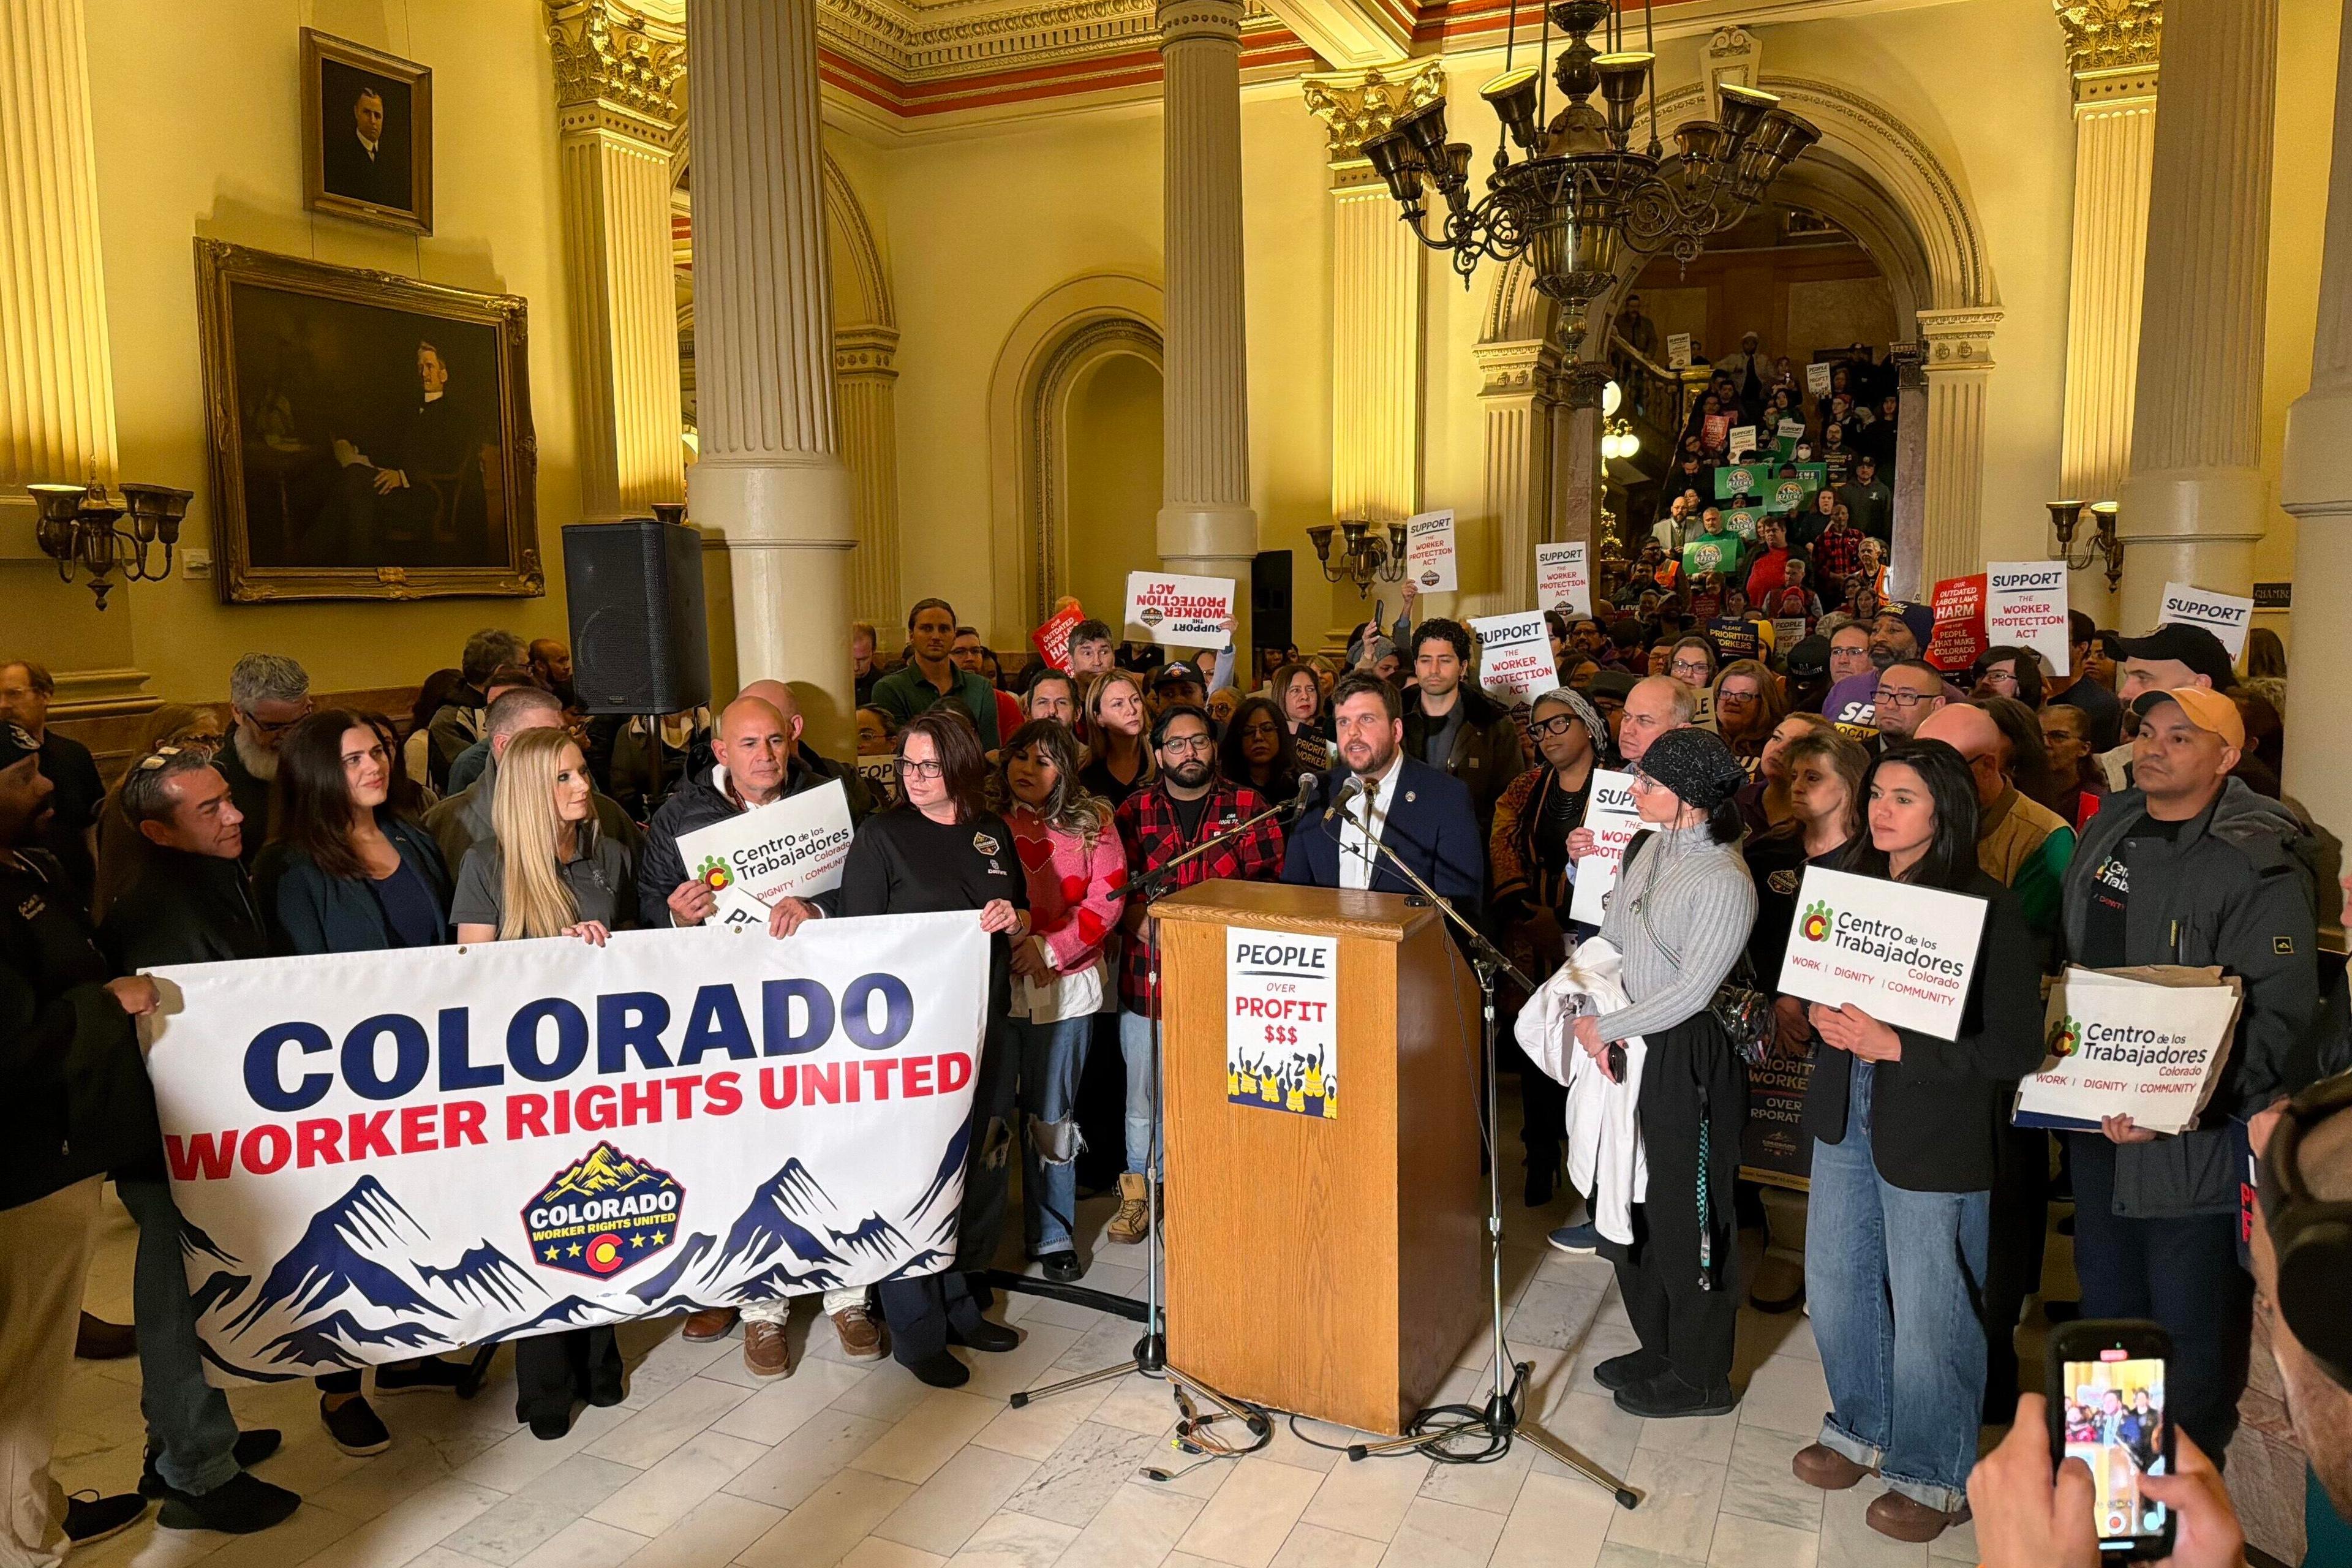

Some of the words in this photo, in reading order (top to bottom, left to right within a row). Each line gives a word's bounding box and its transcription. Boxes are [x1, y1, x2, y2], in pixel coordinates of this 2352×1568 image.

[1411, 518, 1451, 533] SUPPORT
[1416, 540, 1444, 551] WORKER
[1409, 548, 1452, 561] PROTECTION
[1539, 549, 1583, 562] SUPPORT
[1547, 571, 1577, 581] WORKER
[1992, 572, 2062, 587] SUPPORT
[1147, 584, 1175, 595] ACT
[1540, 579, 1586, 589] PROTECTION
[1940, 587, 1977, 598] OUTDATED
[1136, 595, 1226, 608] PROTECTION
[1936, 597, 1958, 606] LABOR
[1959, 595, 1978, 603] LAWS
[1164, 607, 1226, 619] WORKER
[1936, 603, 1975, 620] HARM
[2003, 604, 2051, 614] WORKER
[2166, 598, 2247, 622] SUPPORT
[1051, 619, 1060, 628] OUR
[1172, 623, 1221, 632] SUPPORT
[1992, 616, 2064, 627] PROTECTION
[1043, 617, 1074, 643] OUTDATED
[1476, 622, 1540, 644] SUPPORT
[1709, 628, 1755, 642] PRIORITIZE
[1940, 630, 1967, 639] PEOPLE
[2015, 629, 2038, 638] ACT
[1044, 633, 1063, 652] LABOR
[1717, 638, 1752, 650] ORKERS
[1934, 639, 1952, 647] THAT
[1953, 638, 1975, 646] MAKE
[1934, 646, 1975, 656] COLORADO
[1492, 656, 1537, 672] WORKER
[1943, 655, 1968, 663] GREAT
[1483, 666, 1552, 685] PROTECTION
[1509, 684, 1529, 696] ACT
[1624, 820, 1643, 829] THE
[733, 834, 796, 865] Centro
[798, 831, 810, 842] de
[810, 827, 824, 838] los
[814, 841, 851, 862] Colorado
[736, 828, 849, 881] Trabajadores
[757, 880, 794, 901] DIGNITY
[805, 855, 848, 881] COMMUNIT
[1838, 911, 1902, 941] Centro
[1905, 935, 1918, 946] de
[1921, 937, 1937, 951] los
[1236, 944, 1327, 968] PEOPLE
[1834, 929, 1964, 978] Trabajadores
[1792, 955, 1820, 971] WORK
[1834, 967, 1875, 985] DIGNITY
[1887, 981, 1956, 1006] COMMUNITY
[1907, 968, 1959, 990] Colorado
[1267, 982, 1296, 993] OVER
[1235, 997, 1327, 1022] PROFIT
[1264, 1024, 1298, 1045] $$$
[2087, 1023, 2155, 1044] Centro
[2157, 1034, 2169, 1044] de
[2171, 1034, 2186, 1044] los
[243, 972, 913, 1112] COLORADO
[2084, 1042, 2207, 1066] Trabajadores
[2158, 1066, 2202, 1077] Colorado
[2036, 1073, 2069, 1085] WORK
[2084, 1079, 2128, 1091] DIGNITY
[2139, 1083, 2197, 1094] COMMUNITY
[1766, 1098, 1802, 1111] OVER
[165, 1101, 488, 1181] WORKER
[505, 1071, 741, 1141] RIGHTS
[760, 1051, 972, 1109] UNITED
[530, 1191, 677, 1229] COLORADO
[532, 1226, 586, 1242] WORKER
[587, 1218, 631, 1234] RIGHTS
[634, 1213, 676, 1227] UNITED
